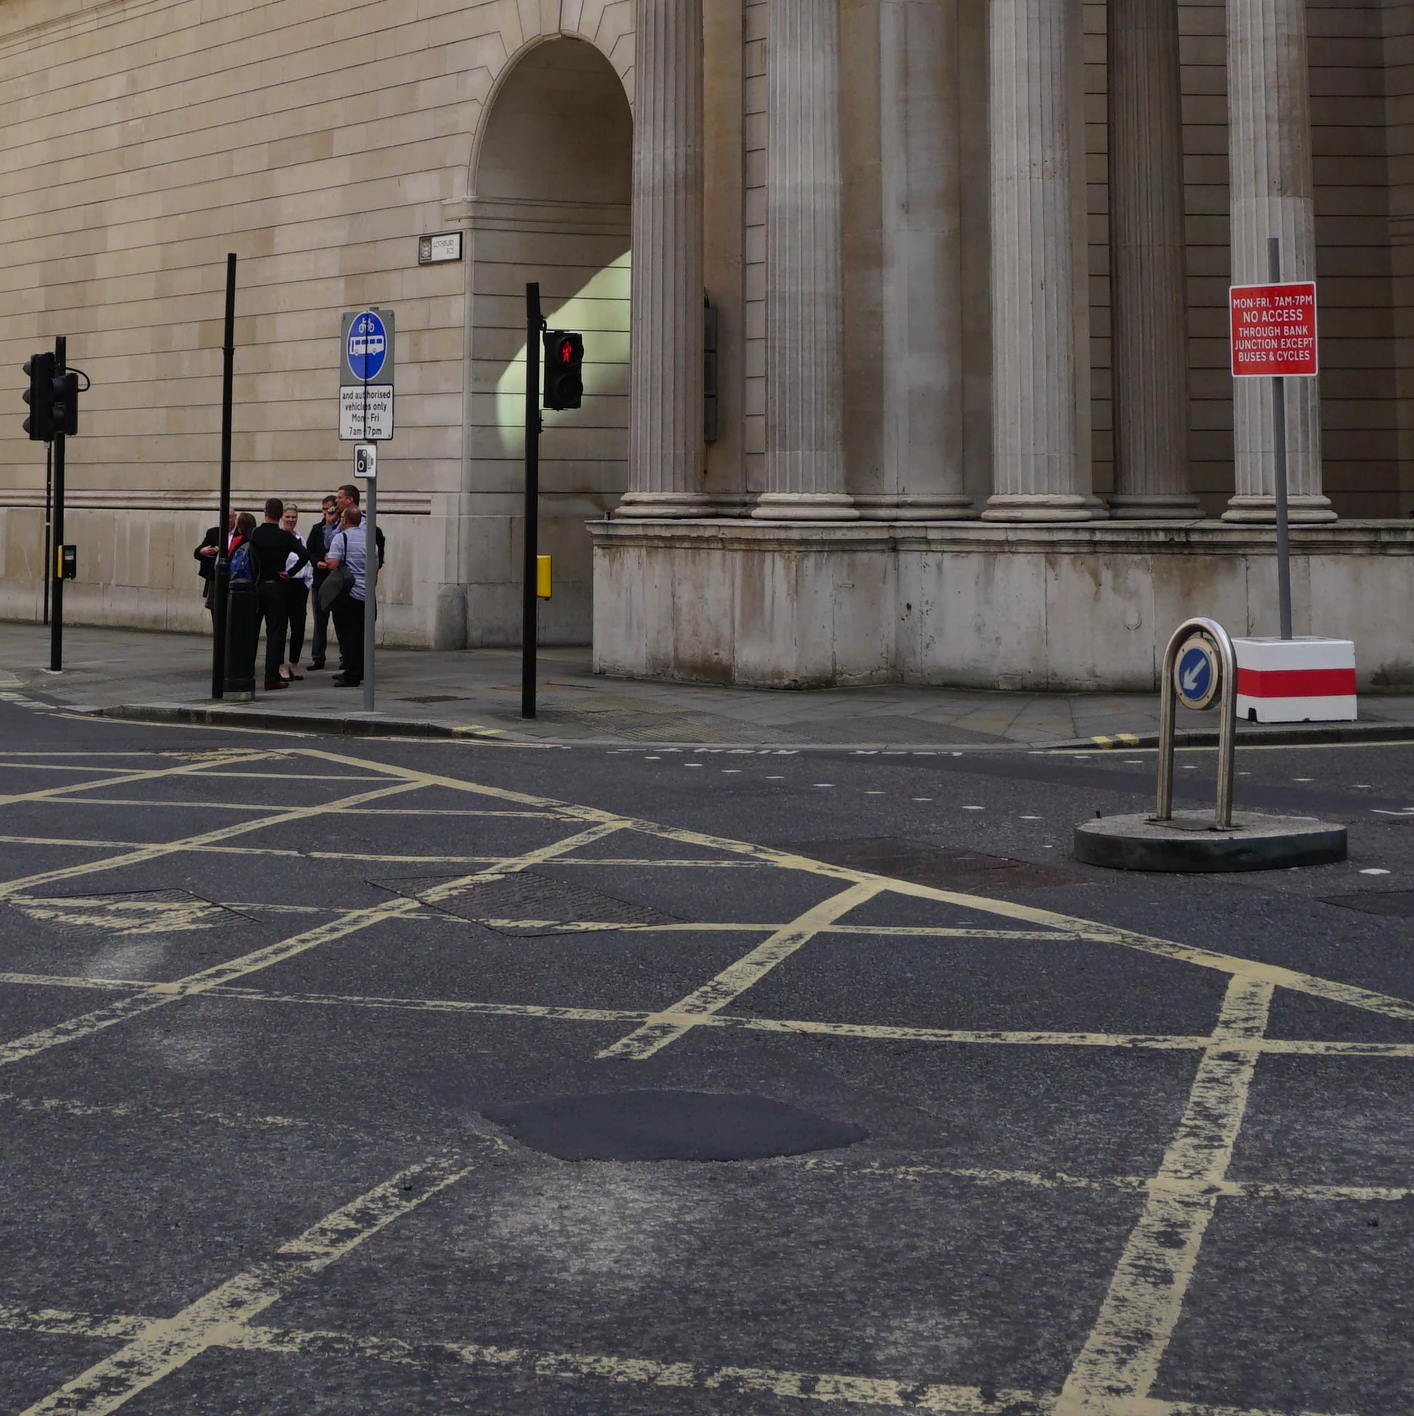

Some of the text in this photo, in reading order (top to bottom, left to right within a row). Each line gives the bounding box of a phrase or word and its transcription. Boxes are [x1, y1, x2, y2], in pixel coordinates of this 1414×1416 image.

[1274, 295, 1313, 306] 7AM-7PM
[1243, 309, 1303, 323] NO ACCESS
[1238, 325, 1309, 337] THROUGH BANK
[1234, 337, 1314, 350] JUNCTION EXCEPT
[1238, 350, 1310, 362] BUSES & CYCLES
[343, 391, 353, 399] and
[373, 401, 387, 412] only
[351, 413, 365, 423] Mon
[370, 413, 380, 422] Fri
[349, 426, 363, 435] 7am
[367, 426, 383, 437] 7pm
